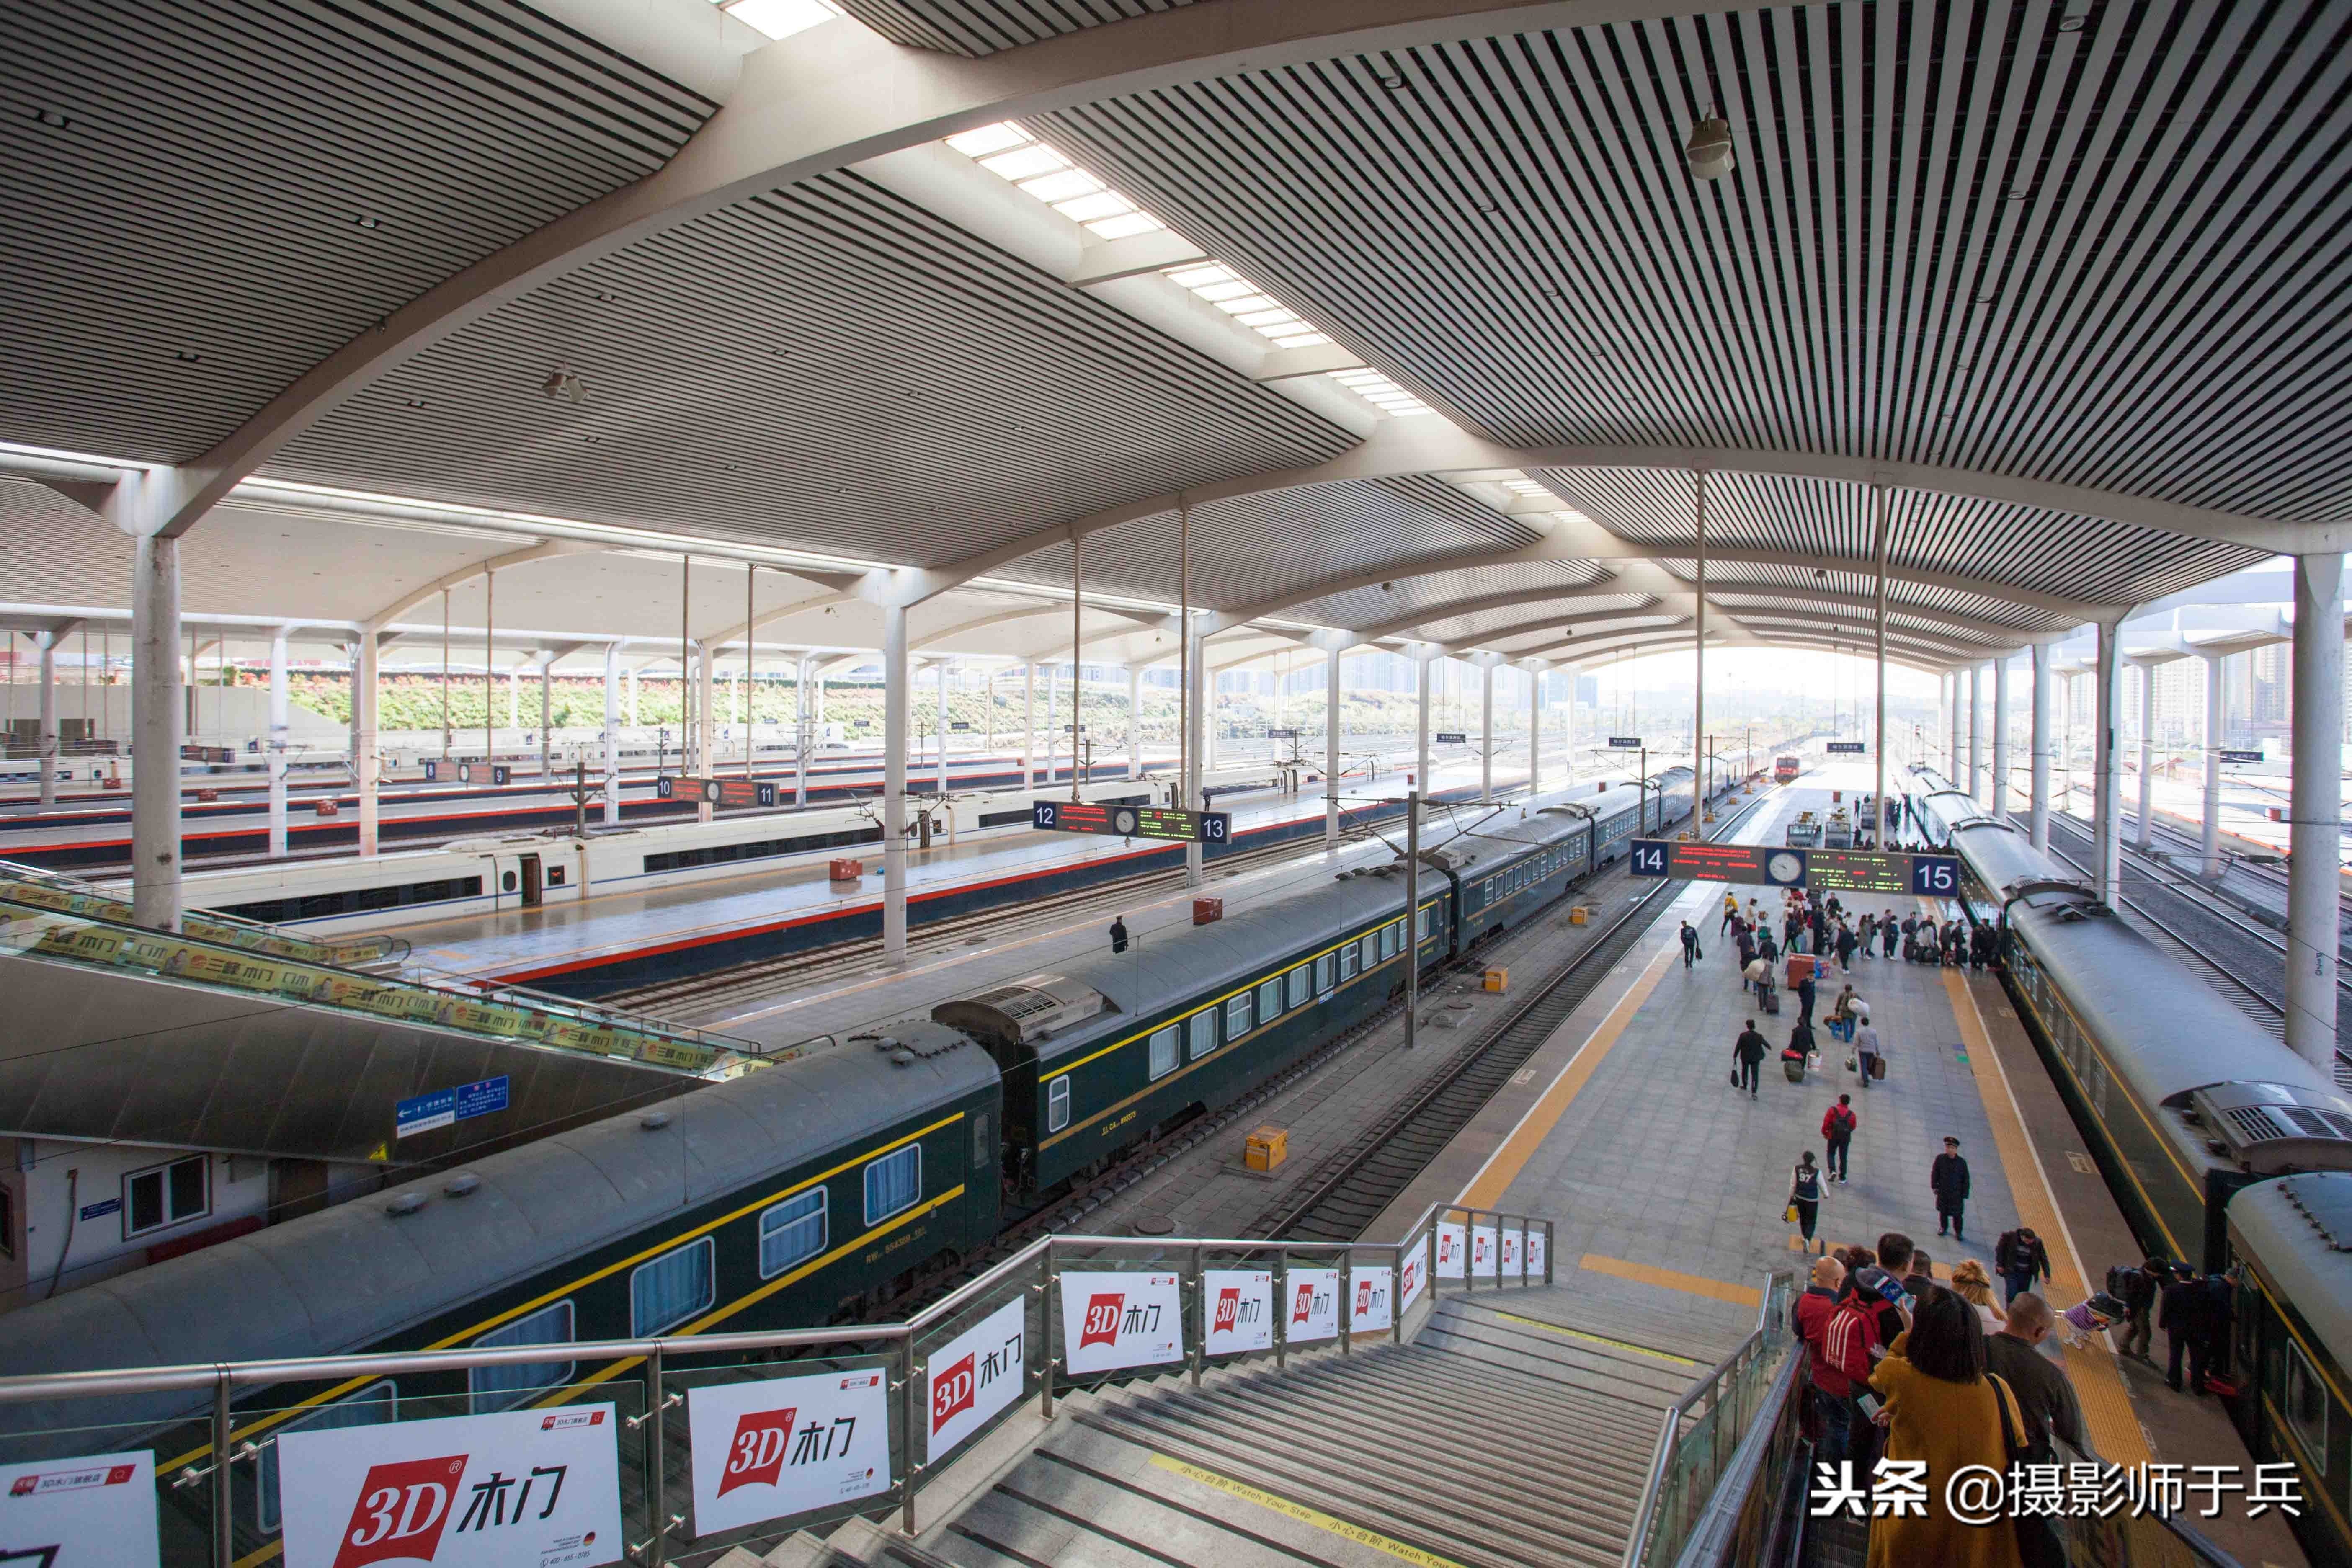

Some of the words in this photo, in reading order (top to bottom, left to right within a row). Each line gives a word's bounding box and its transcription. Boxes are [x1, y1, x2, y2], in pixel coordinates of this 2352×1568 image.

[428, 764, 434, 777] 8
[496, 769, 503, 782] 9
[659, 780, 670, 795] 10
[761, 787, 771, 802] 11
[1036, 807, 1054, 825] 12
[1203, 819, 1224, 838] 13
[1635, 847, 1663, 871] 14
[1918, 864, 1952, 890] 15
[1798, 1172, 1812, 1183] 97
[1217, 1298, 1236, 1323] 3D
[1237, 1297, 1261, 1323] 木门
[1295, 1292, 1311, 1314] 3D
[1311, 1292, 1330, 1315] 木门
[1086, 1305, 1119, 1334] 3D
[1122, 1304, 1161, 1334] 木门
[935, 1370, 972, 1418] 3D
[980, 1333, 1021, 1389] 木门
[730, 1427, 785, 1474] 3D
[789, 1416, 856, 1466] 木门
[351, 1481, 448, 1546] 3D
[455, 1464, 568, 1534] 木门
[1180, 1466, 1229, 1488] 小心台阶
[1233, 1483, 1262, 1501] Watch
[1266, 1496, 1287, 1510] Your
[1289, 1506, 1312, 1520] Step
[1329, 1520, 1383, 1546] 小心台阶
[1387, 1542, 1421, 1560] Watch
